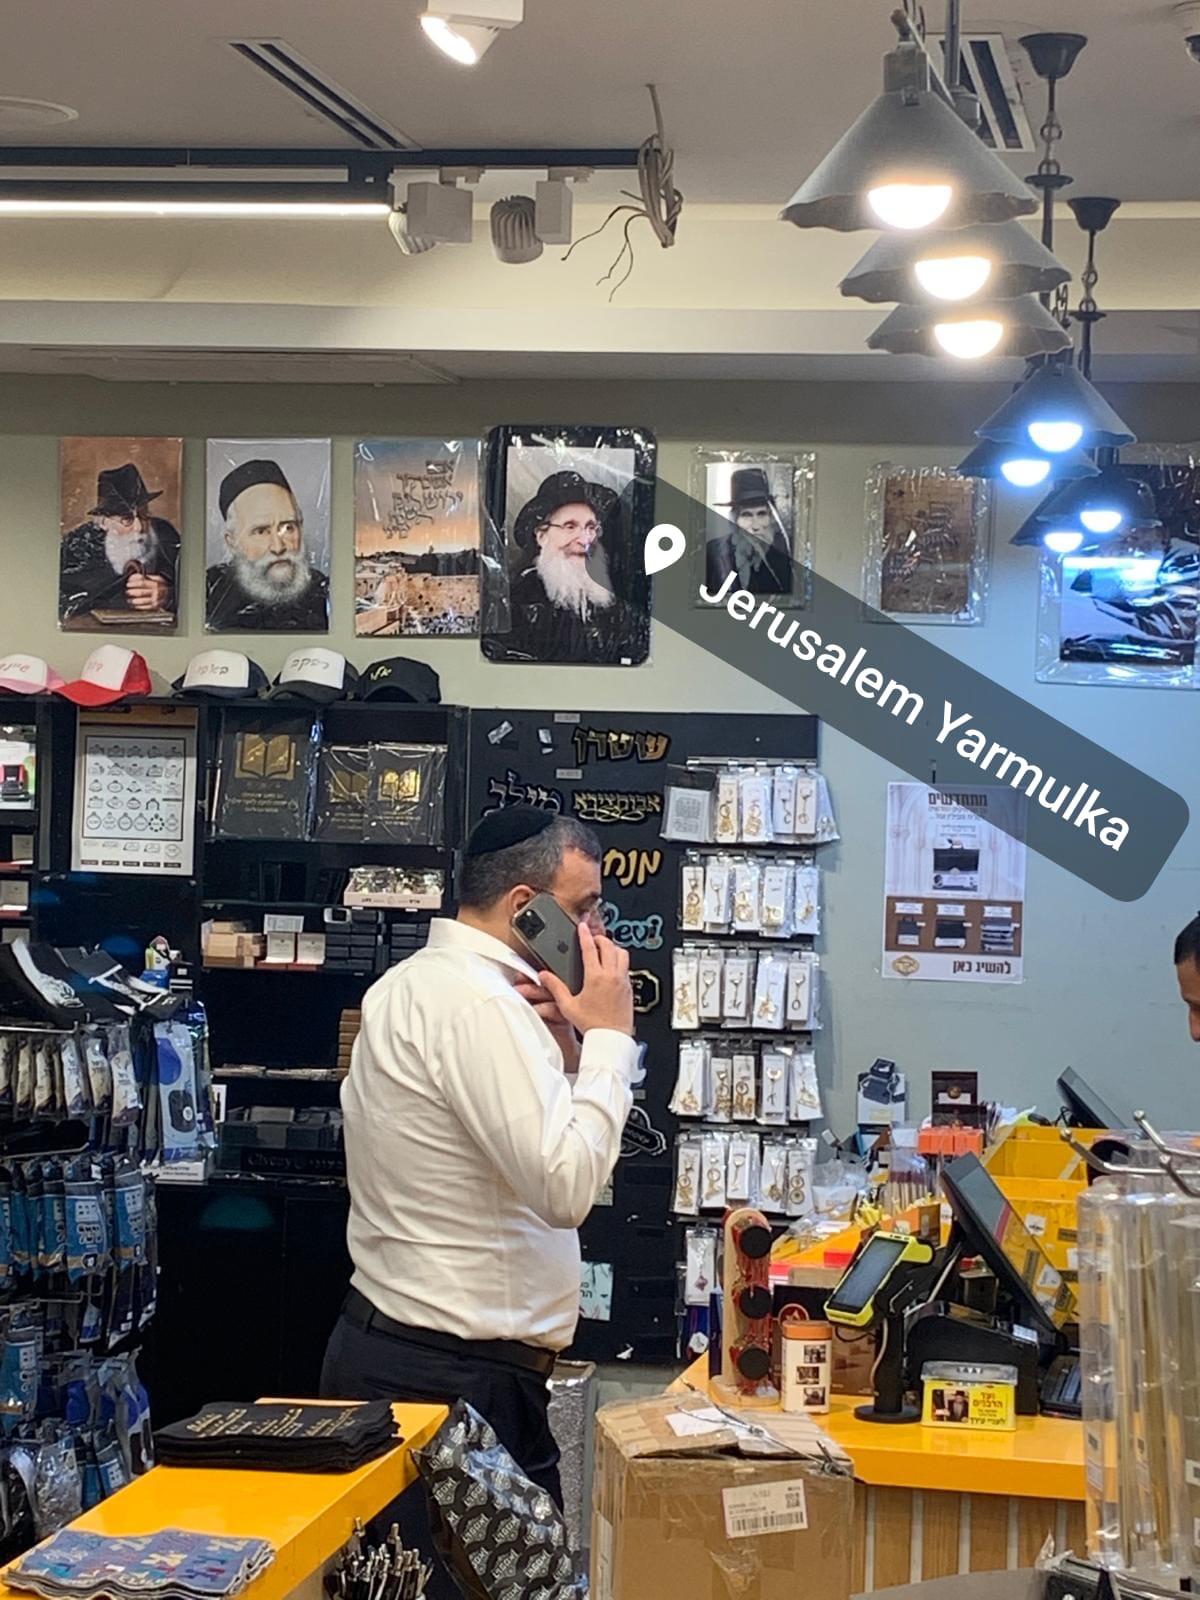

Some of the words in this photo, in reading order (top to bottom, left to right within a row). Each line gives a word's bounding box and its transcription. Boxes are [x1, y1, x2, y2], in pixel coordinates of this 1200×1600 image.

[574, 728, 669, 764] שטרן
[928, 792, 988, 807] מתחדשים
[602, 848, 662, 887] מנח
[953, 960, 972, 974] כאן
[975, 960, 1012, 974] להשיג
